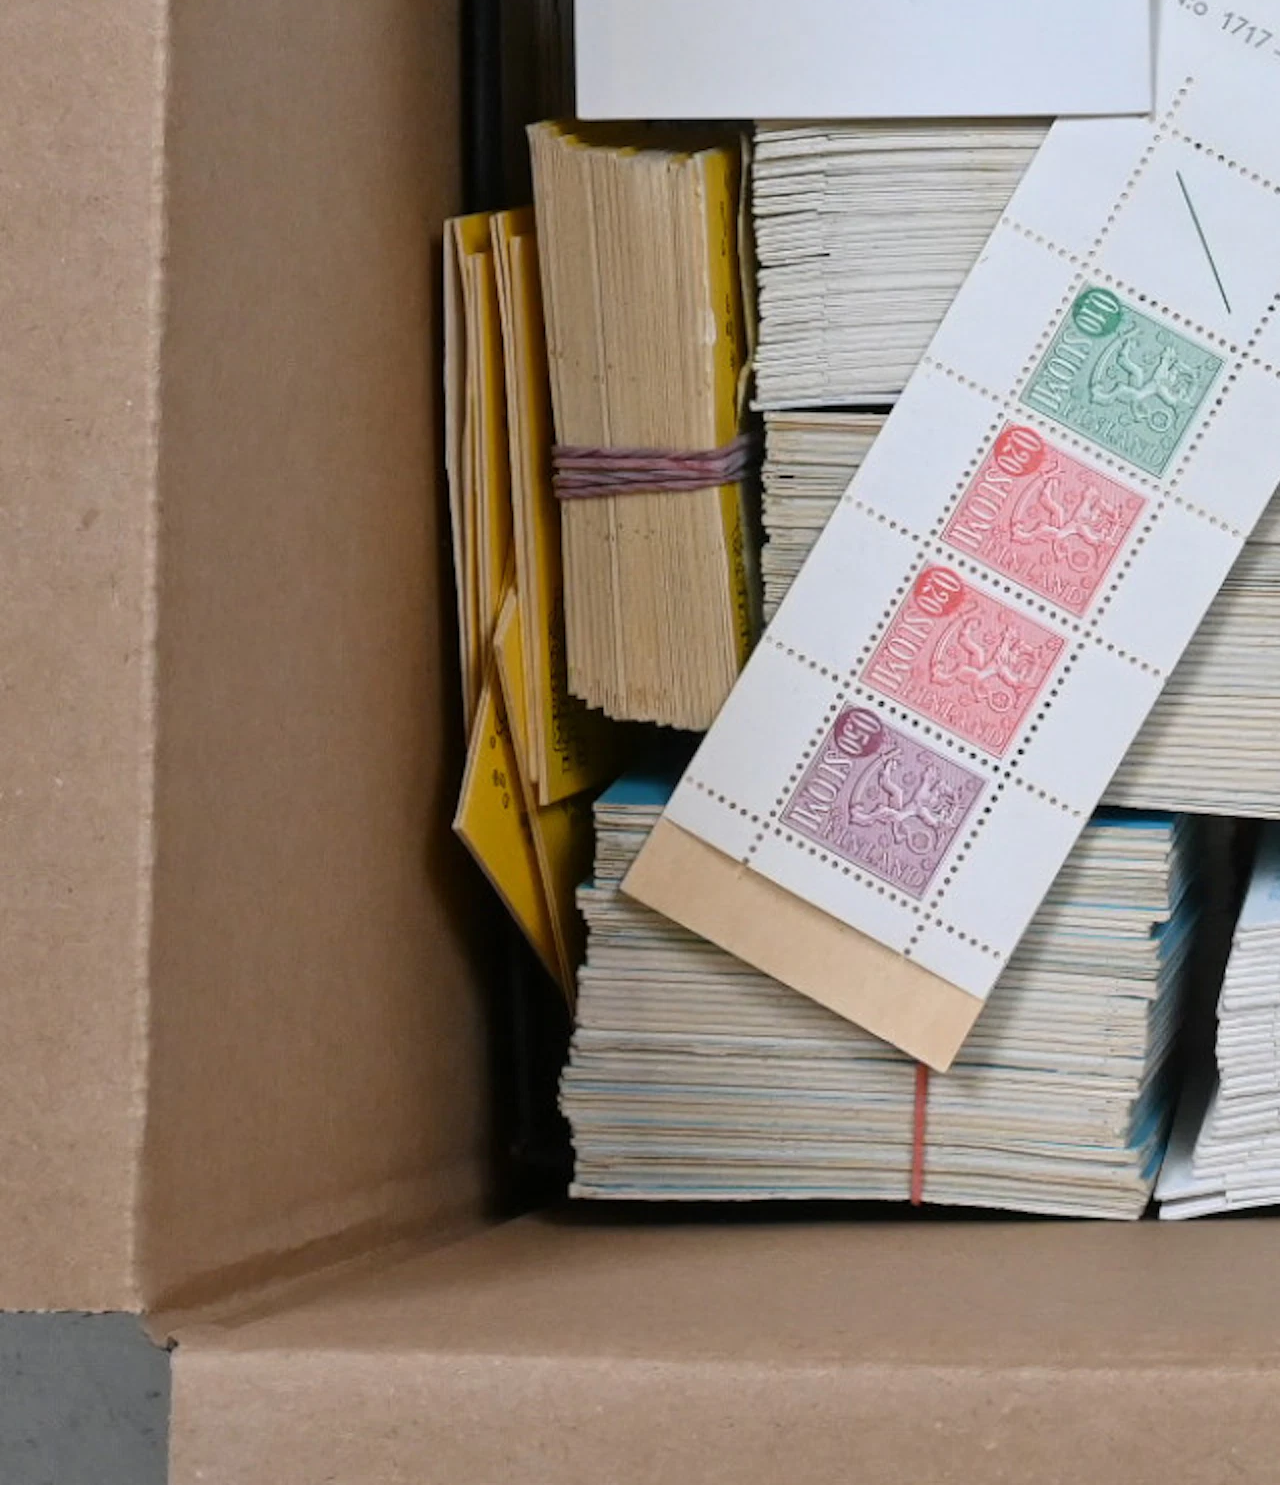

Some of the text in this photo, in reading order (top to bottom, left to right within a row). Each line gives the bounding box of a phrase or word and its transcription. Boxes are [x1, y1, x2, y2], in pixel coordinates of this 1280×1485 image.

[1030, 329, 1094, 412] SUOMI
[949, 466, 1013, 549] SUOMI
[870, 608, 935, 689] SUOMI
[789, 750, 853, 830] SUOMI
